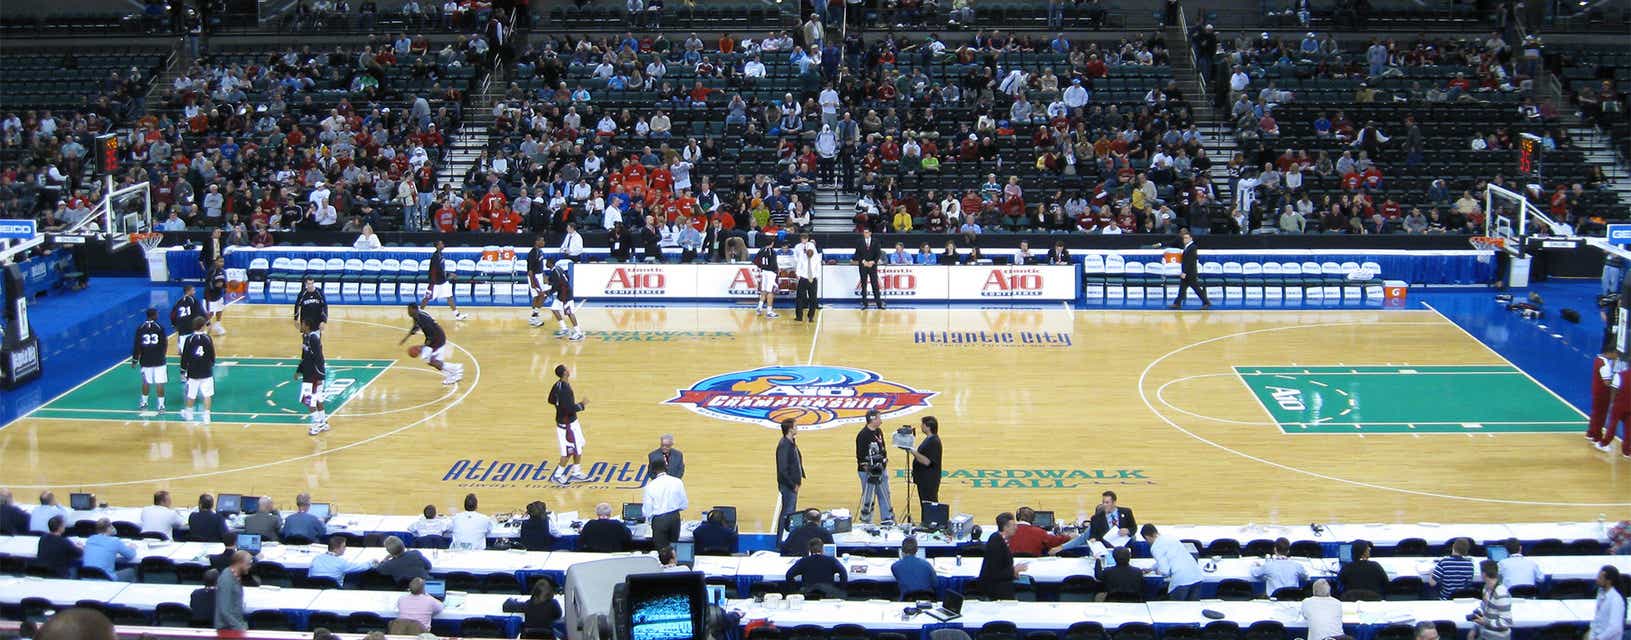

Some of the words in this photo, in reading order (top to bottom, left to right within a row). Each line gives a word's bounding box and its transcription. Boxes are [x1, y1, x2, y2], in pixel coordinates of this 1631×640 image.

[606, 268, 666, 288] A10
[982, 269, 1044, 290] A10
[178, 306, 192, 317] 21
[143, 333, 159, 345] 33
[195, 345, 205, 357] 4
[1264, 385, 1306, 410] A10
[971, 479, 1079, 489] HALL
